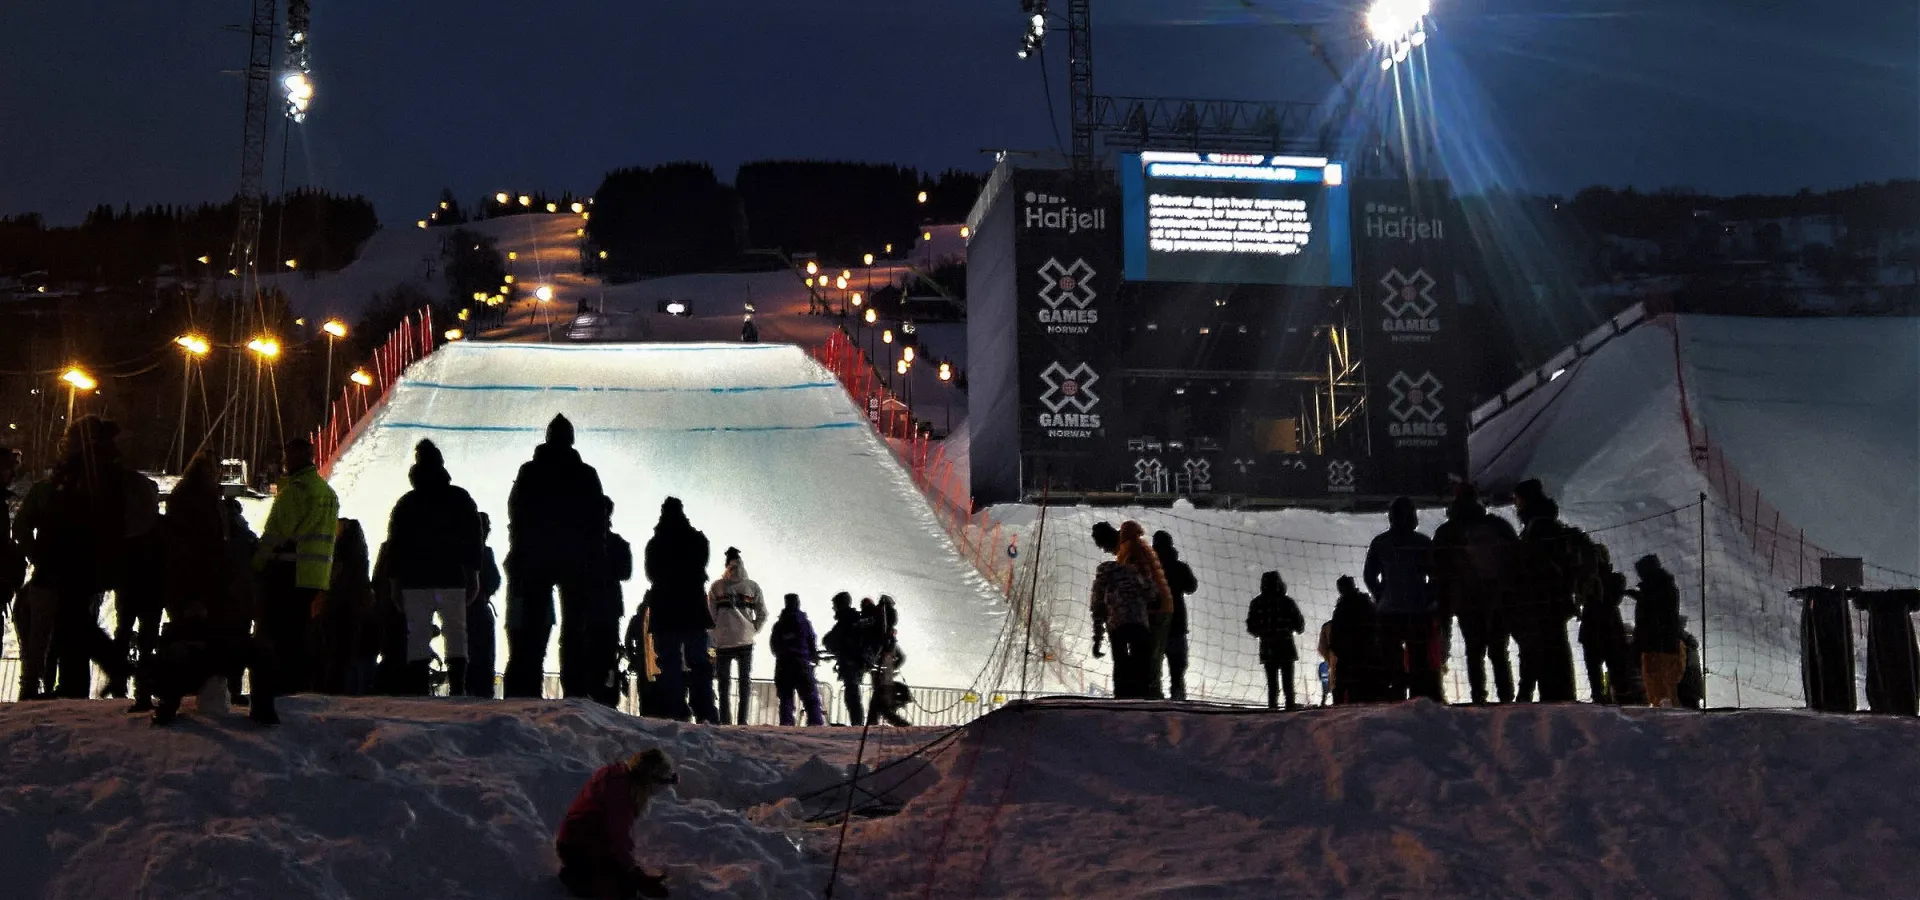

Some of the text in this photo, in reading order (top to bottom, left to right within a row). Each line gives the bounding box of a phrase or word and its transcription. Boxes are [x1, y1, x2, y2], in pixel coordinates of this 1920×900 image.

[1025, 206, 1105, 233] Hafjell
[1365, 215, 1444, 243] Hafjell
[1038, 309, 1098, 324] GAMES
[1047, 325, 1090, 334] NORWAY
[1382, 318, 1440, 332] GAMES
[1039, 413, 1101, 427] GAMES
[1048, 429, 1092, 438] NORWAY
[1388, 422, 1448, 436] GAMES
